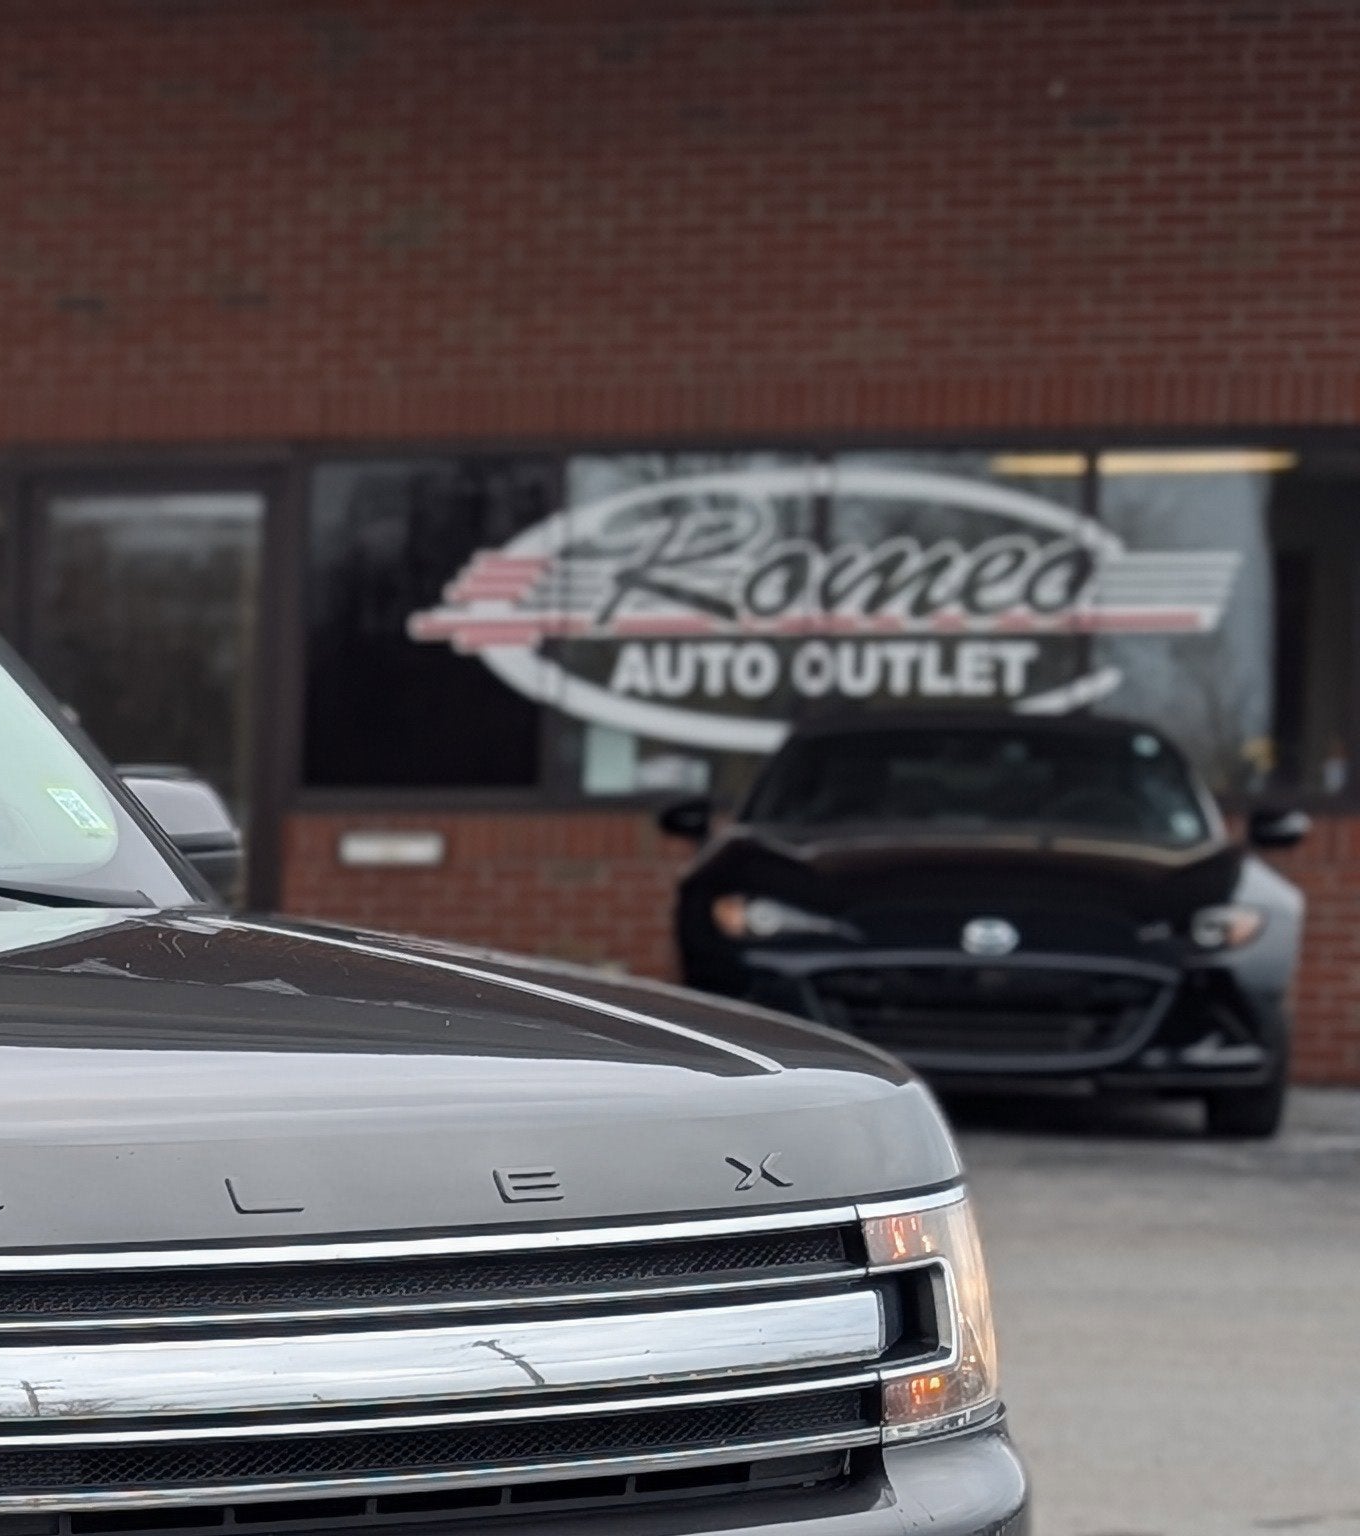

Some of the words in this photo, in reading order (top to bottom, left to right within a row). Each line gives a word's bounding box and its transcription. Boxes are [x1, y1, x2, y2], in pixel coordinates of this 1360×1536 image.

[592, 508, 1096, 626] Romeo
[609, 640, 779, 699] AUTO
[791, 640, 1040, 699] OUTLET
